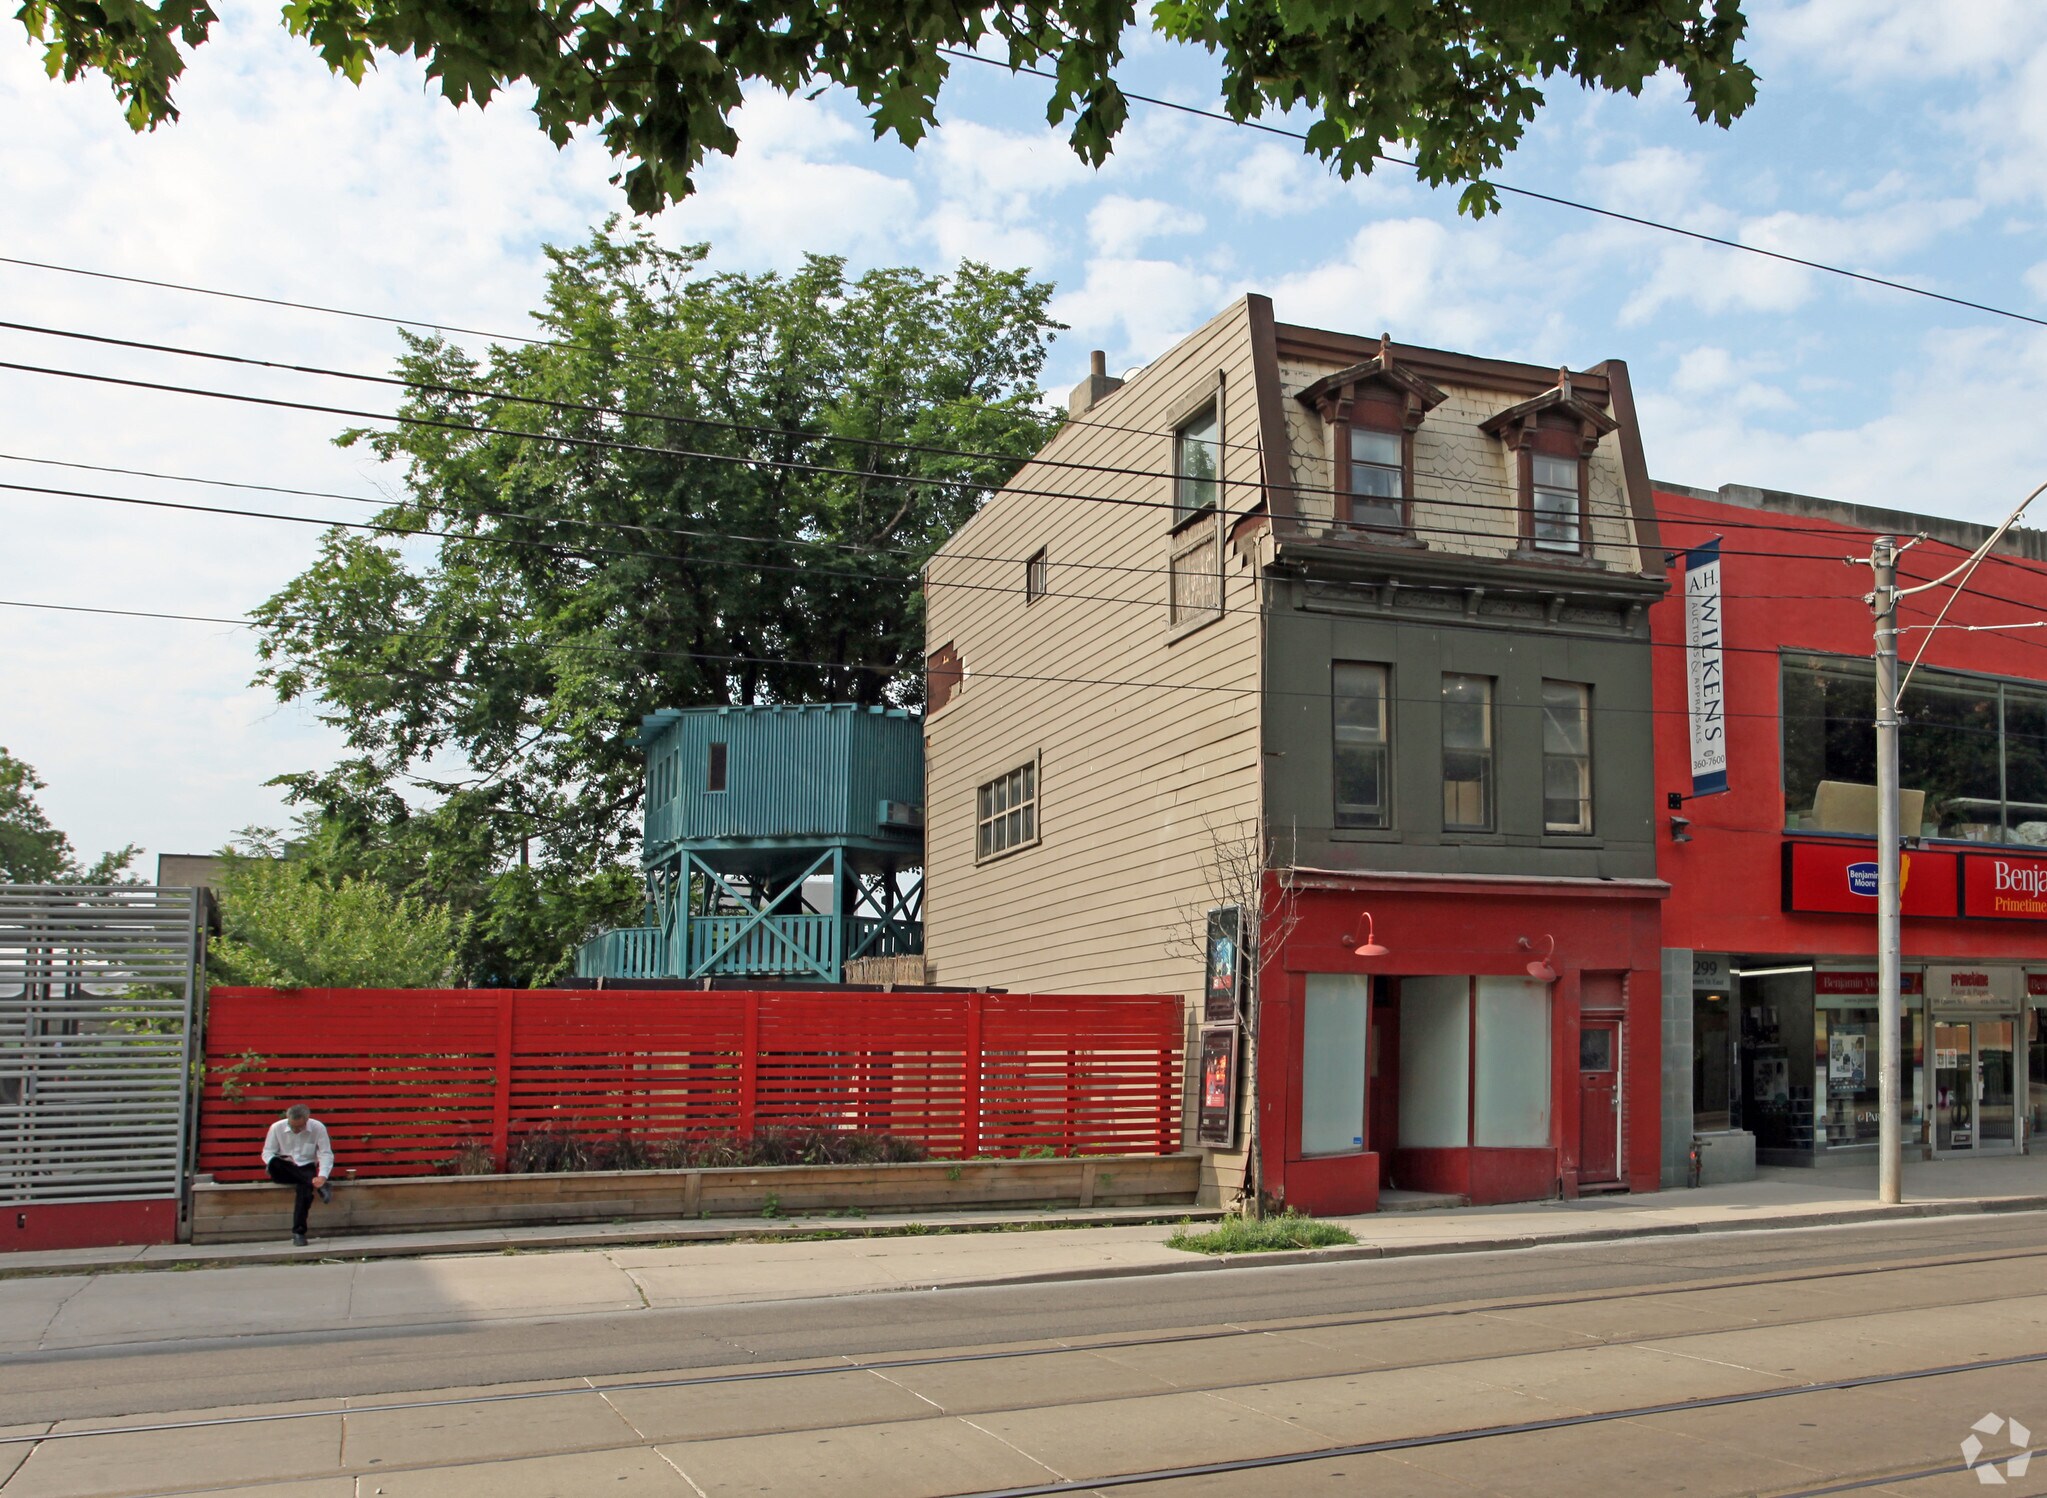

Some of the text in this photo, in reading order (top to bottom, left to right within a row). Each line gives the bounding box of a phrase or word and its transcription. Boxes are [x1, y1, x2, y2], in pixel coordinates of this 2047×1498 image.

[1689, 570, 1718, 593] A.H.
[1691, 602, 1700, 658] AUCTIONS
[1690, 660, 1702, 674] &
[1701, 593, 1722, 741] WILKENS
[1855, 879, 1876, 887] Moore
[1995, 896, 2047, 913] Primetime
[1693, 961, 1717, 976] 299
[1824, 977, 1863, 990] Benjamin
